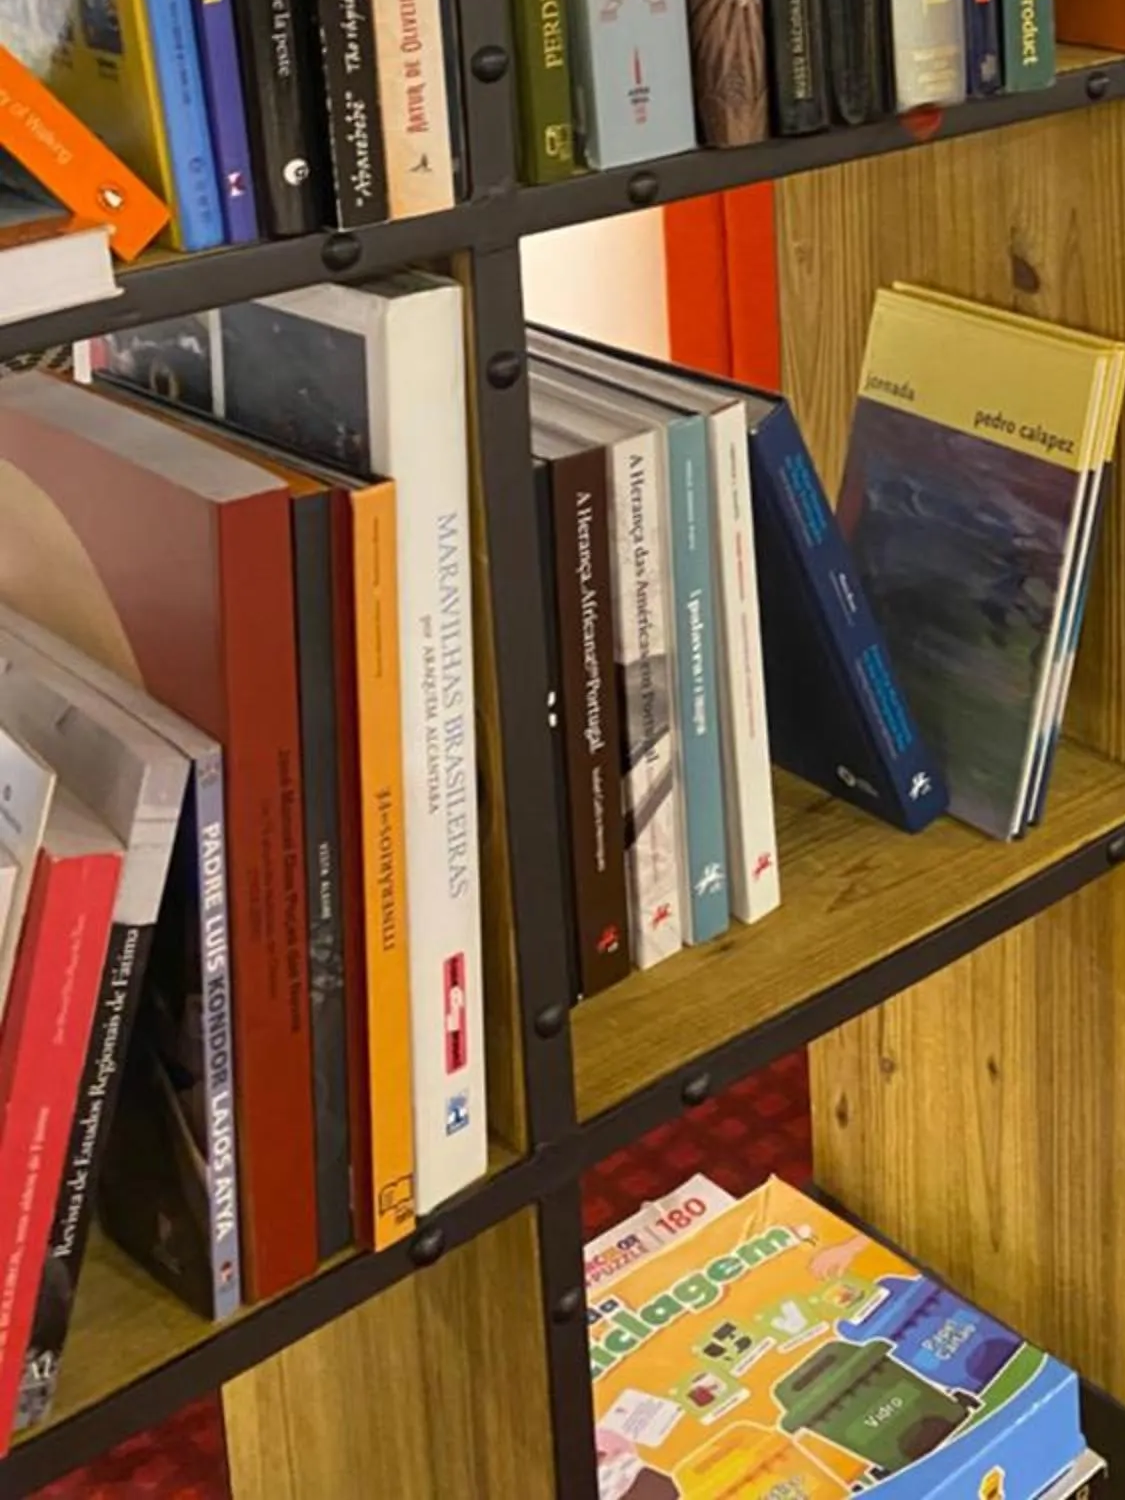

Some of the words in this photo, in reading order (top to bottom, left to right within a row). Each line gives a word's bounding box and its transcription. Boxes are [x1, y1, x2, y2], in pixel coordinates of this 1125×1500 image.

[272, 36, 292, 78] peste
[403, 59, 420, 78] DE
[404, 83, 430, 134] ARTUR
[865, 377, 916, 402] jornada
[628, 454, 643, 470] A
[974, 409, 1016, 436] pedro
[1019, 426, 1075, 457] calapez
[628, 472, 648, 544] Herança
[575, 507, 594, 581] Herança
[634, 546, 650, 577] das
[418, 614, 432, 641] por
[435, 511, 463, 710] MARAVILHAS
[635, 579, 655, 661] Américas
[584, 678, 606, 753] Portugal
[442, 713, 470, 900] BRASILEIRAS
[202, 821, 224, 910] PADRE
[108, 927, 140, 987] Fátima
[103, 989, 127, 1012] de
[206, 973, 231, 1088] KONDOR
[87, 1014, 122, 1097] Regionais
[71, 1099, 104, 1166] Estudos
[210, 1090, 232, 1171] LAJOS
[69, 1170, 89, 1191] de
[214, 1176, 235, 1242] ATYA
[50, 1194, 84, 1258] Revista
[655, 1196, 709, 1236] 180
[590, 1226, 794, 1382] iclagem
[864, 1396, 904, 1429] Vidro
